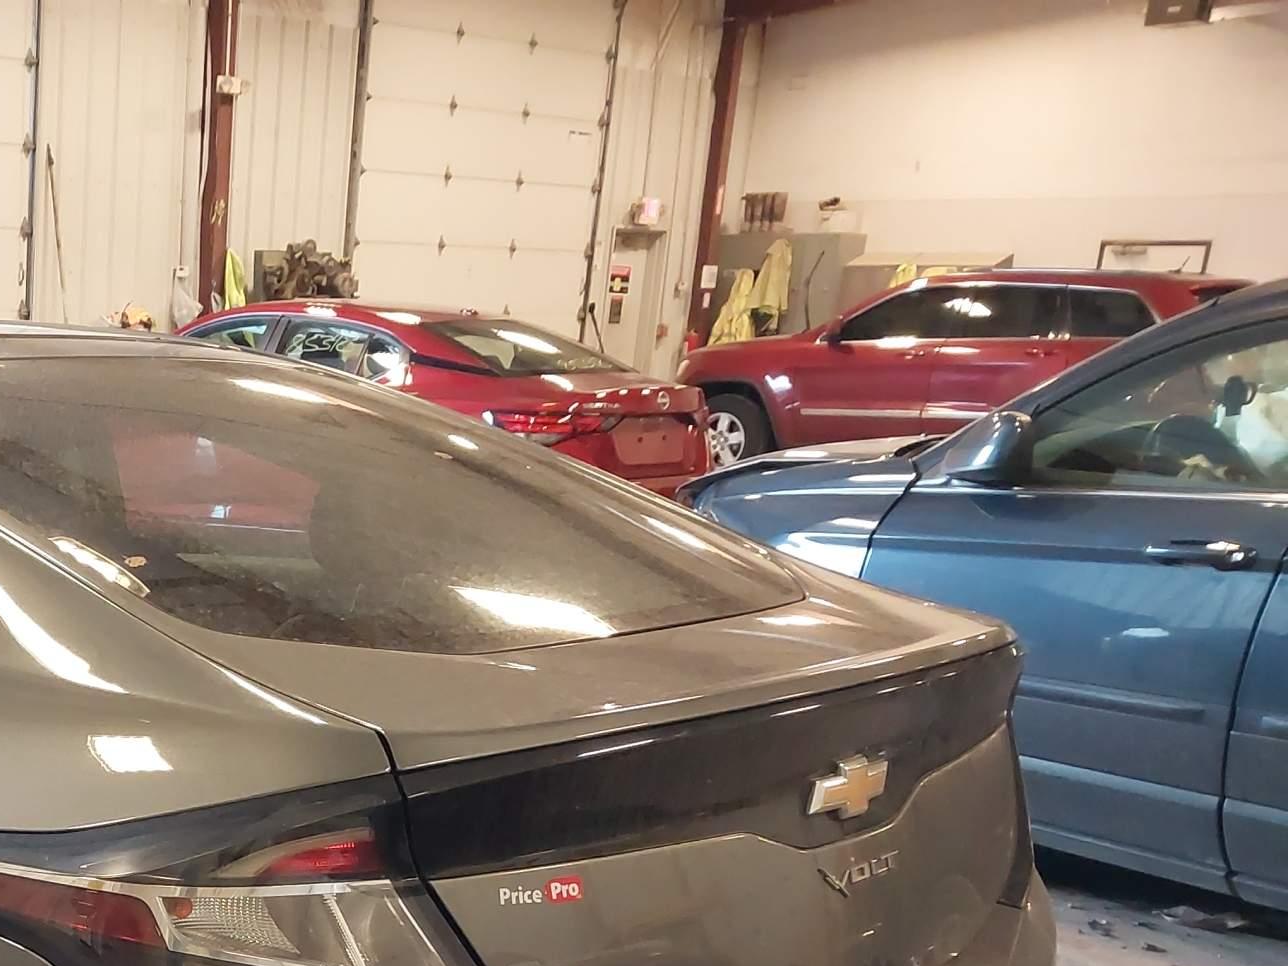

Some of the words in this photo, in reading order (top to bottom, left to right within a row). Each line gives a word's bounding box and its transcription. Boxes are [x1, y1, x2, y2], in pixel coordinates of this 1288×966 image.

[817, 850, 899, 898] VOLT
[499, 885, 543, 905] Price
[550, 882, 579, 900] Pro
